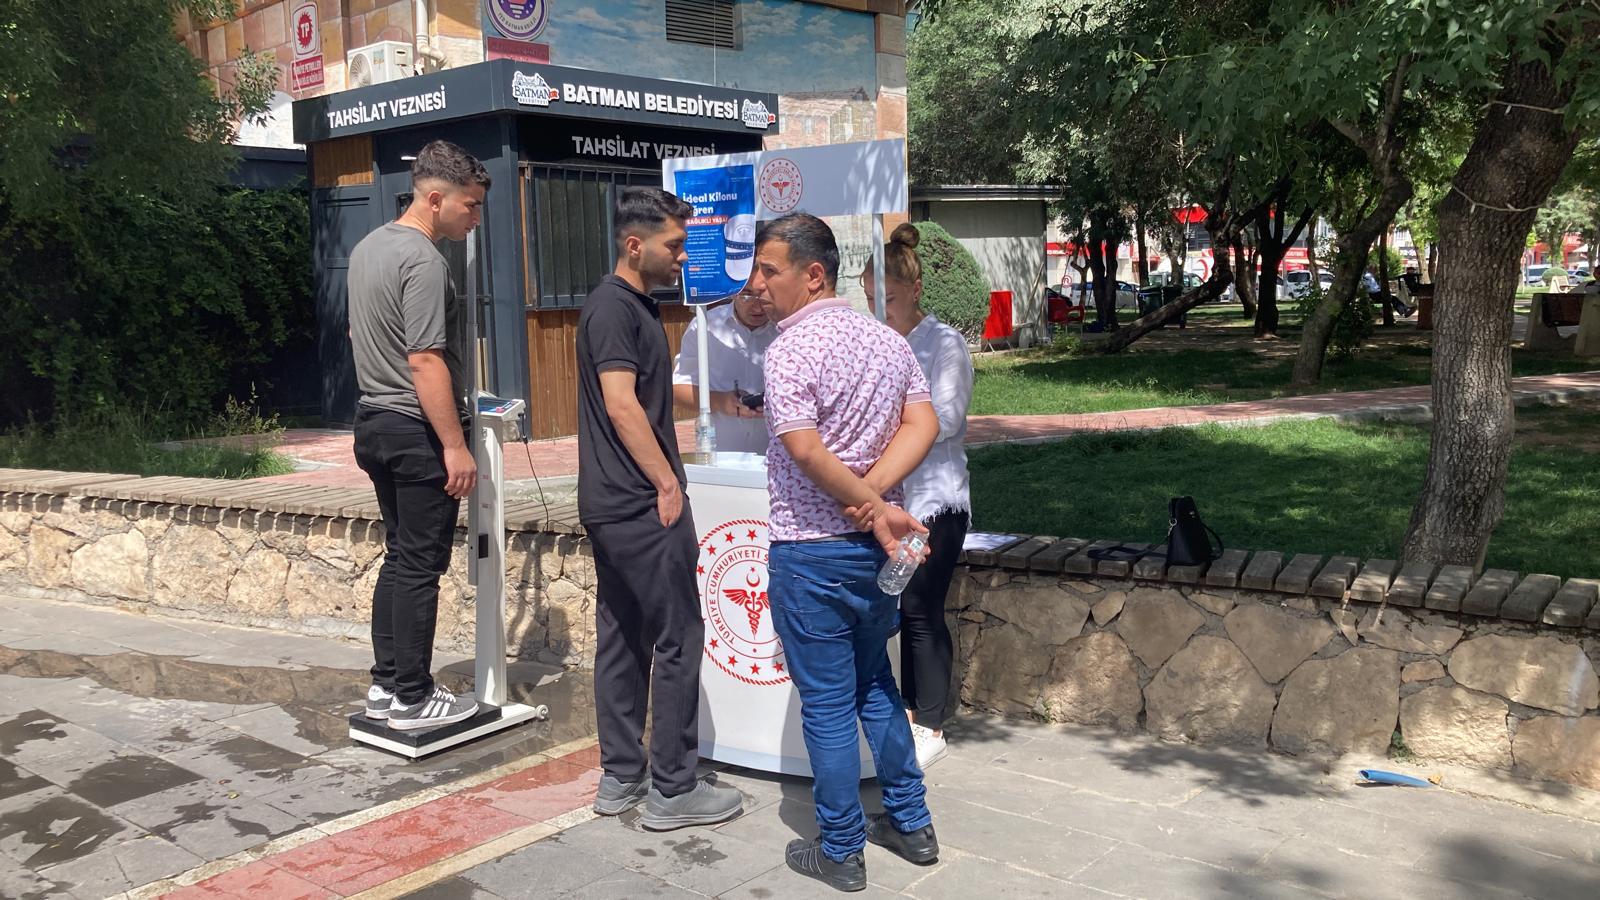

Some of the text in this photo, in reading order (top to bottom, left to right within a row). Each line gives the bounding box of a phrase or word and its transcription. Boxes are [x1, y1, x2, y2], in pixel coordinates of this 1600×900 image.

[327, 85, 447, 129] TAHSİLAT VEZNESİ
[514, 85, 549, 99] BATMAN
[563, 83, 738, 120] BATMAN BELEDİYESİ
[571, 134, 650, 159] TAHSİLAT
[708, 191, 738, 202] Kilonu
[709, 549, 760, 645] TÜRKİYE CUMHURİYETİ
